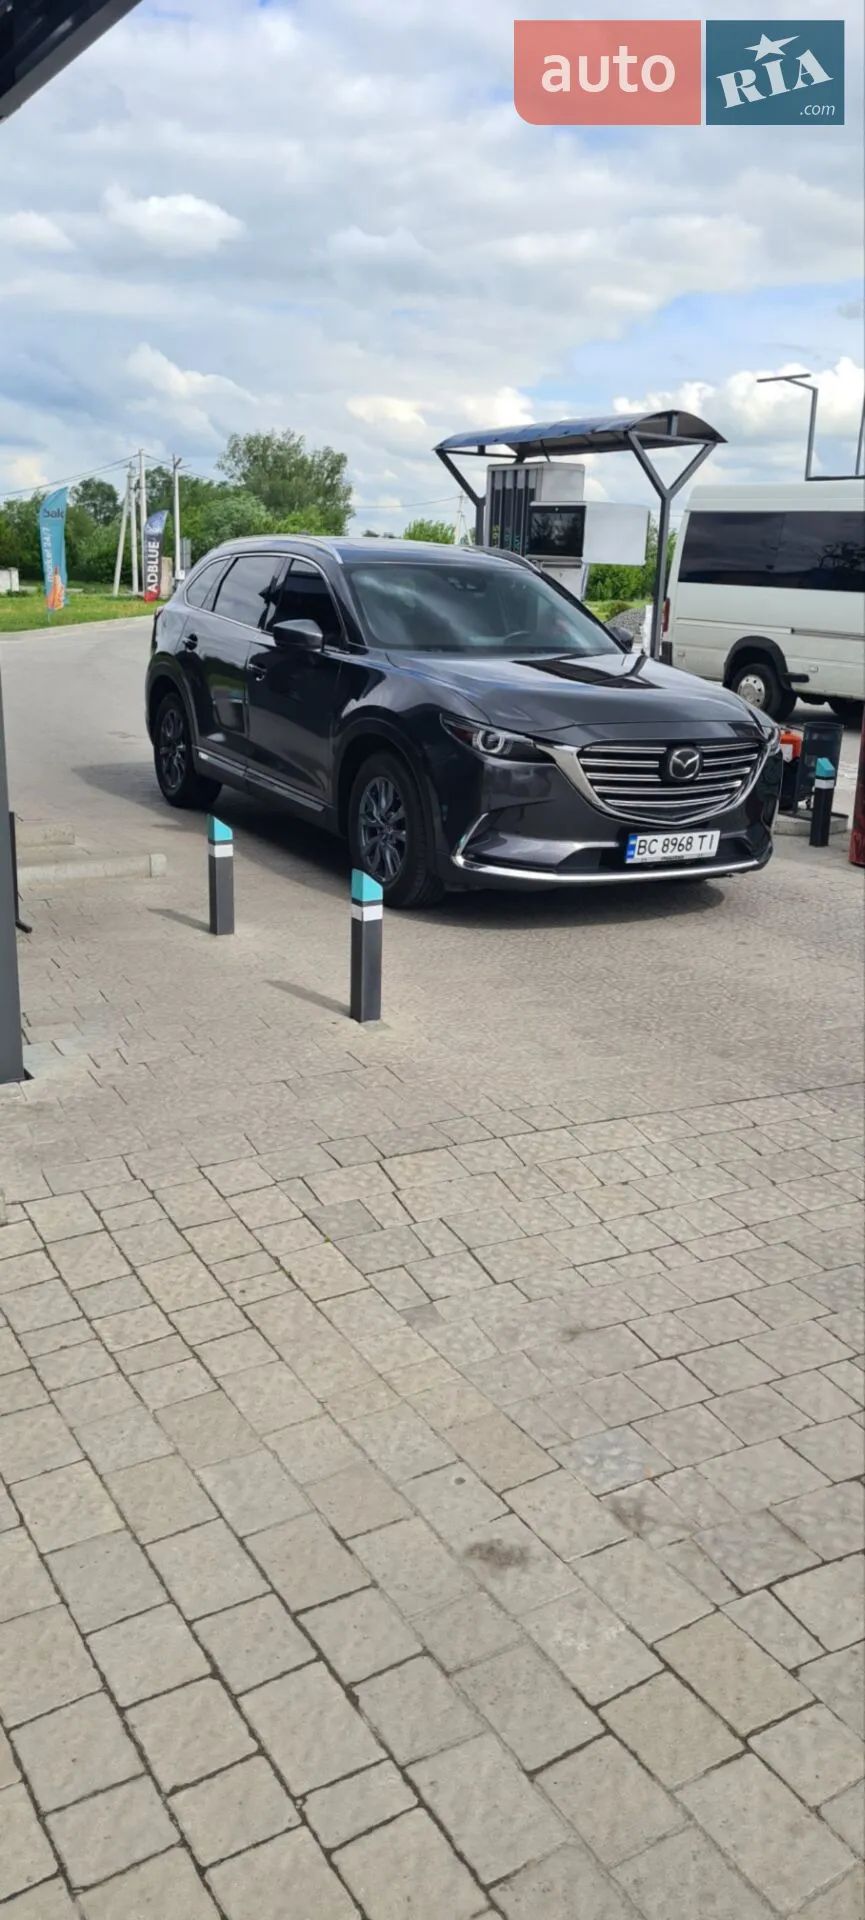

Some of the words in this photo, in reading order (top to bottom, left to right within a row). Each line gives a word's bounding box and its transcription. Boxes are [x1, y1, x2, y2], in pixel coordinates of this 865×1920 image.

[147, 541, 160, 593] ADBLUE
[637, 838, 658, 856] BC
[661, 836, 694, 854] 8968
[698, 834, 714, 851] TI
